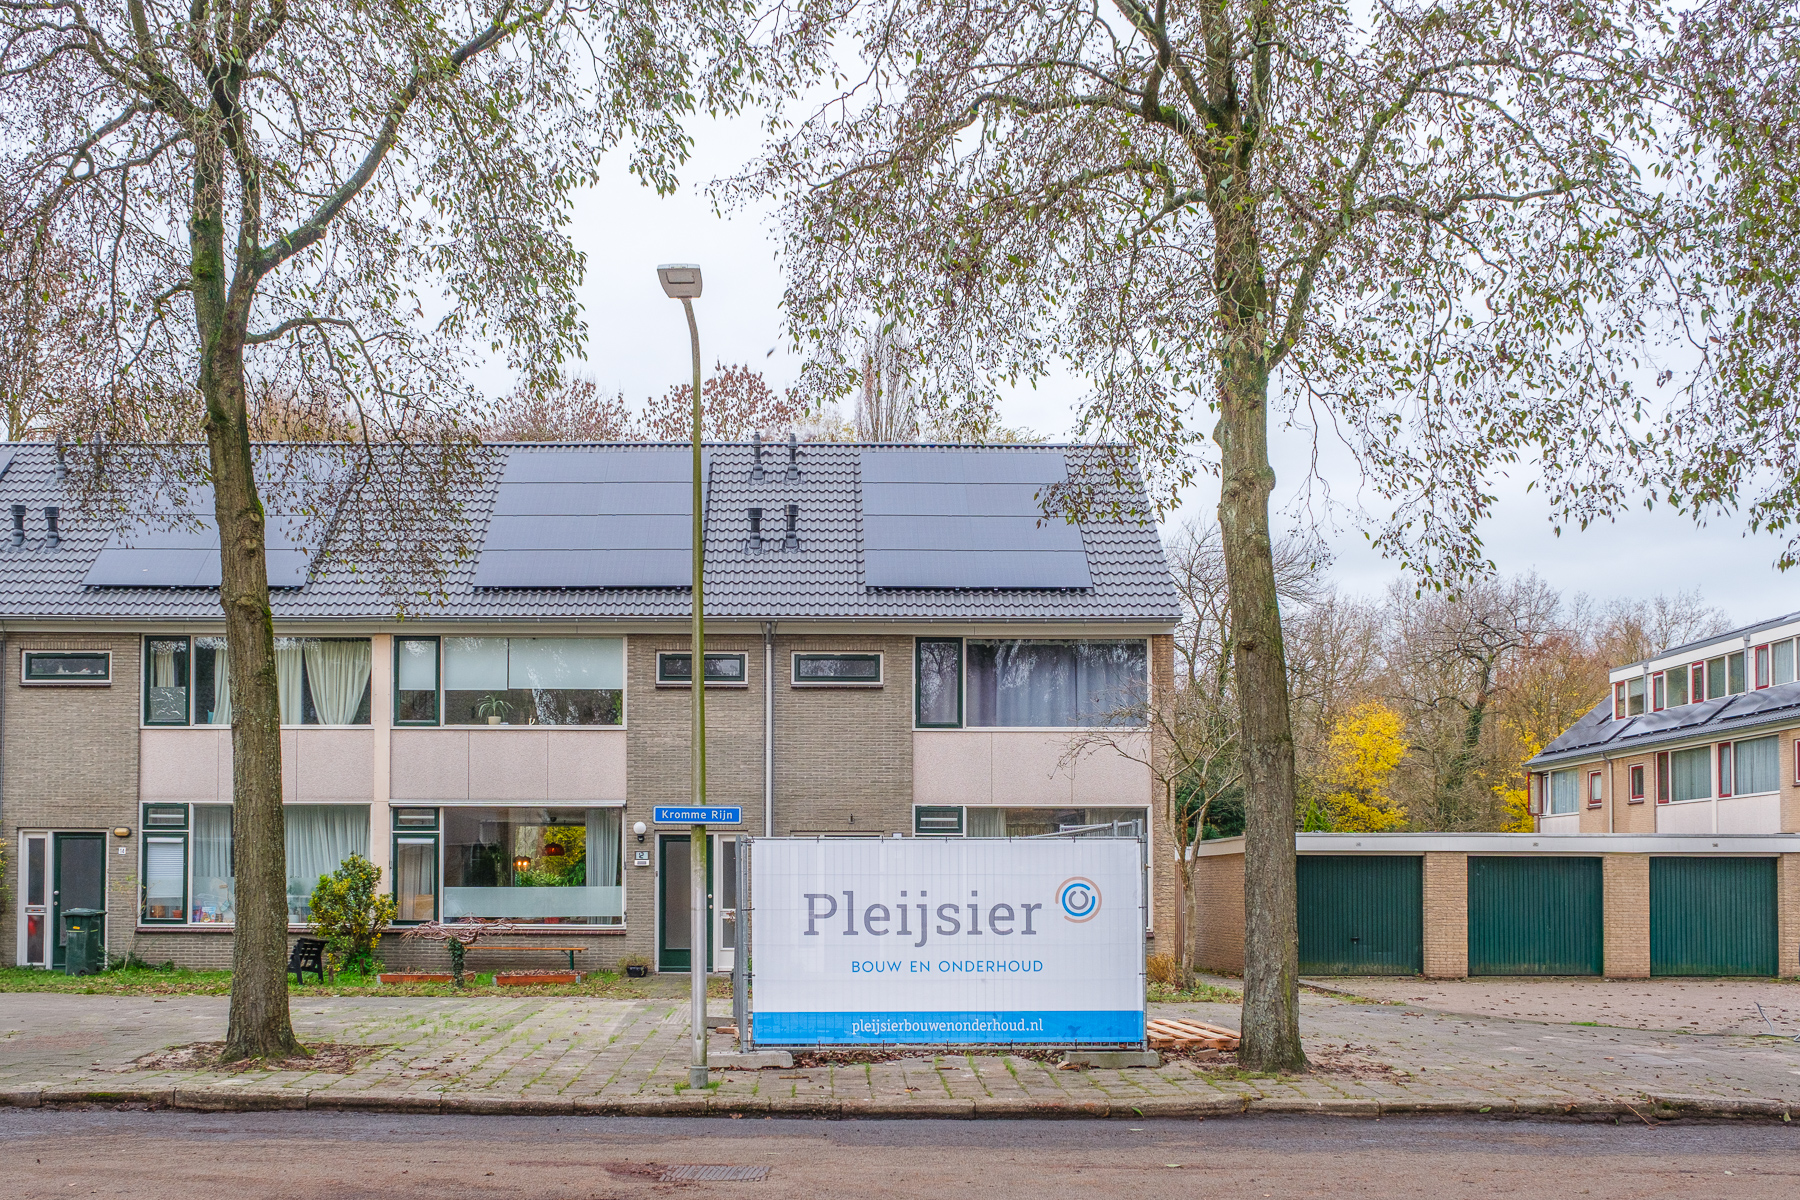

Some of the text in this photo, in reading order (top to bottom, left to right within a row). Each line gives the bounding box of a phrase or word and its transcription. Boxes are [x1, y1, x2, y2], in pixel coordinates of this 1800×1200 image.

[661, 810, 733, 820] Kromme Rijn
[803, 890, 1043, 948] Pleijsier
[851, 960, 1044, 973] BOUW EN ONDERHOUD
[851, 1018, 1044, 1036] pleijsierbouwenonderhoud.nl
